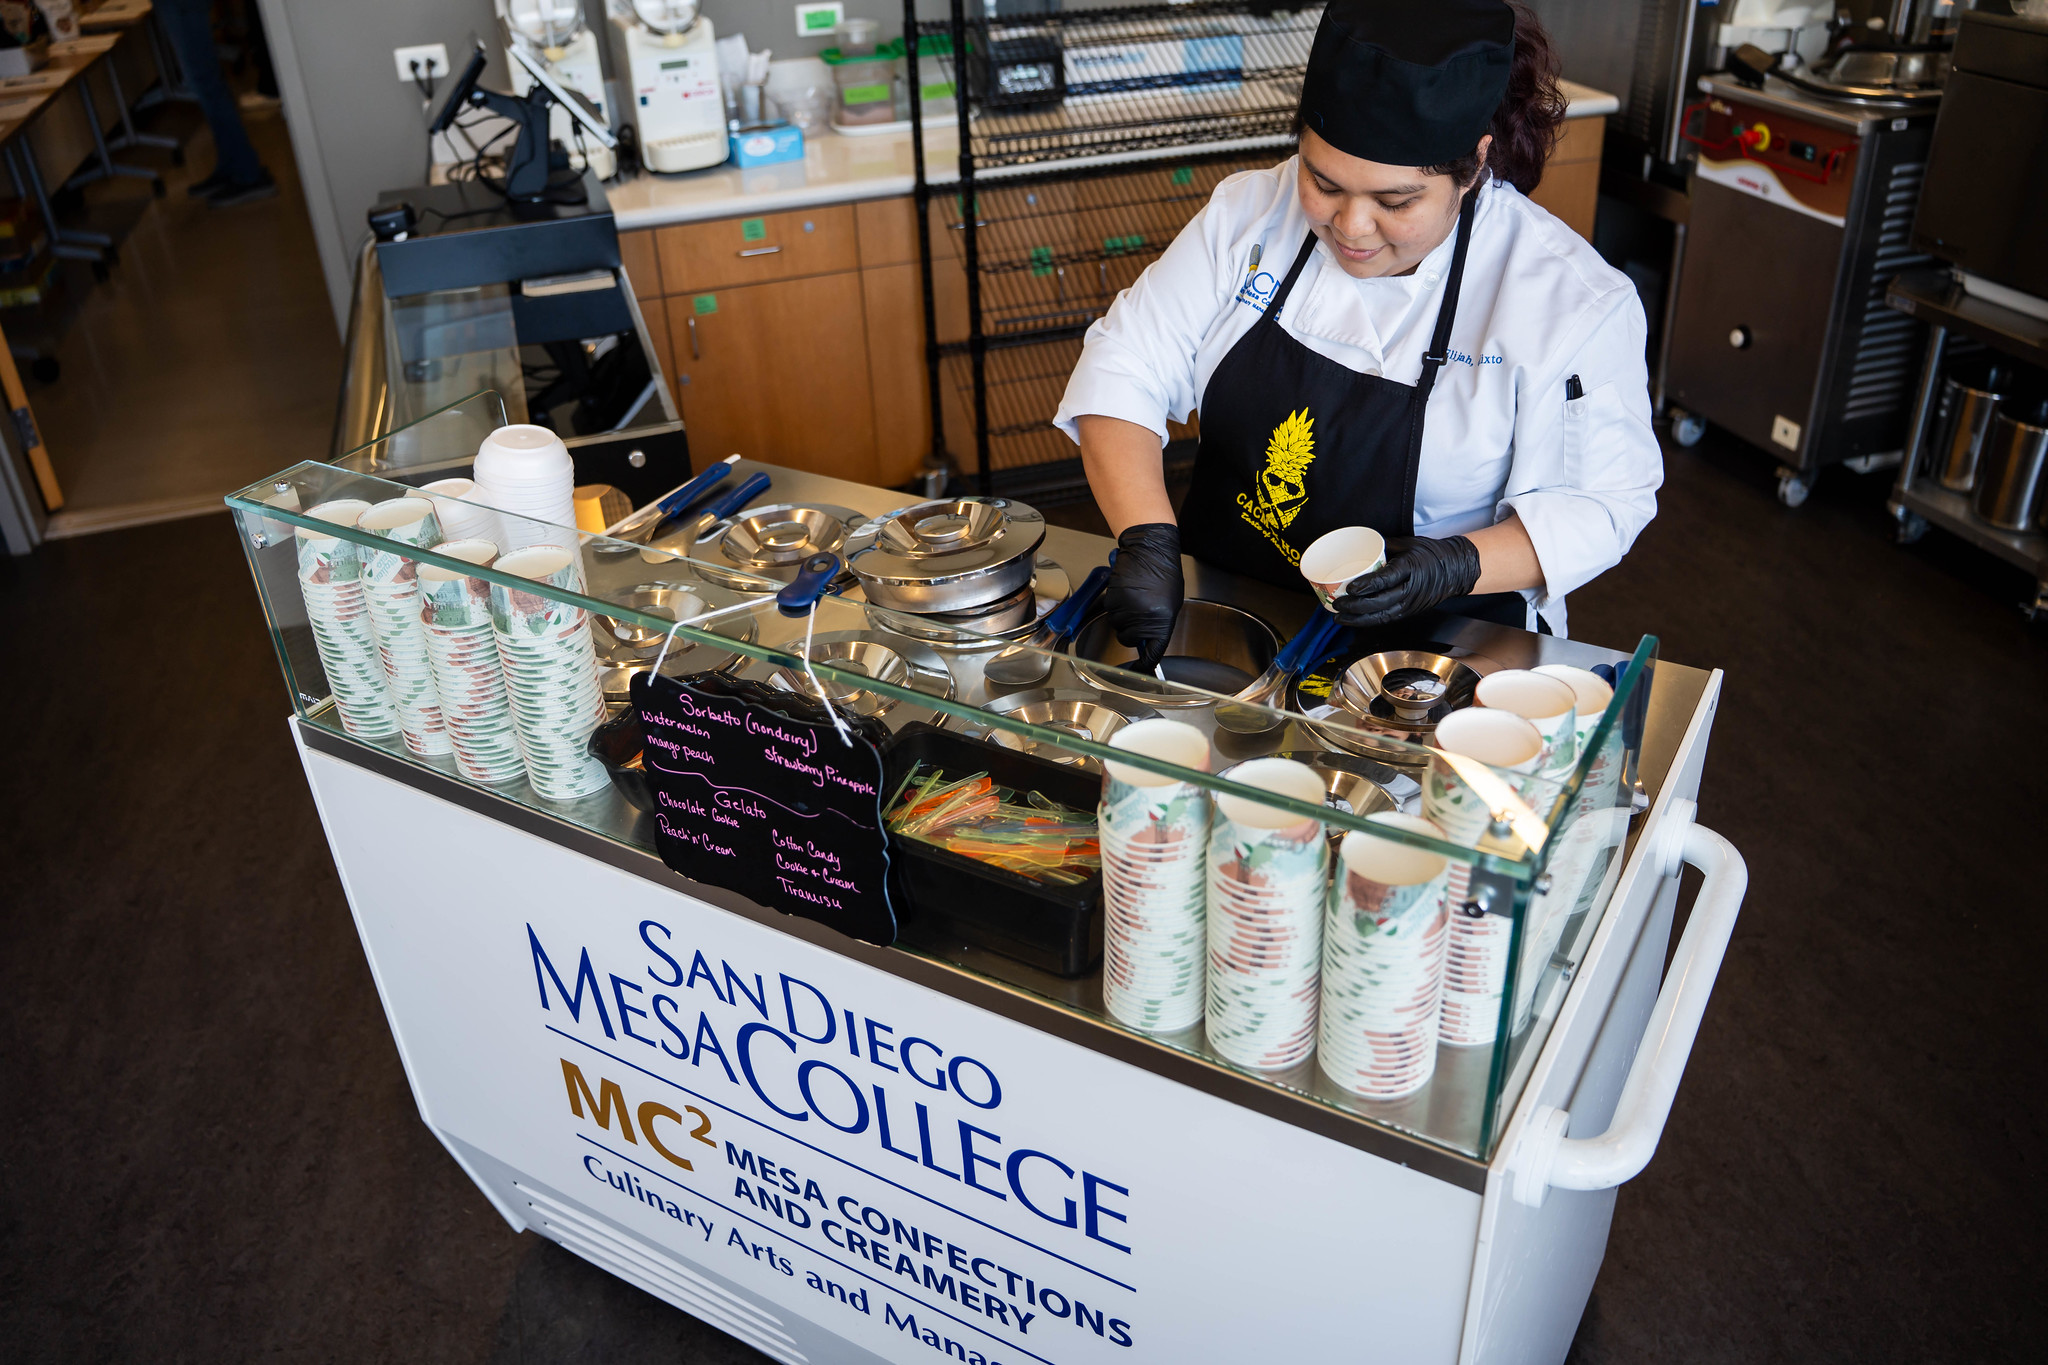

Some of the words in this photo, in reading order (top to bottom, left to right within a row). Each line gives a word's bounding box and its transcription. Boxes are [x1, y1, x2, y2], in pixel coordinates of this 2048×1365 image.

[1478, 353, 1503, 366] ixto
[679, 693, 741, 727] Sorbetto
[647, 734, 681, 760] mango
[682, 745, 716, 765] peach
[825, 764, 877, 796] Pineapple
[659, 791, 707, 817] Chocolate
[711, 807, 740, 829] Cookie
[714, 790, 767, 820] Gelato
[702, 833, 737, 858] Cream
[772, 828, 804, 853] Cotton
[807, 840, 841, 872] Candy
[776, 852, 809, 876] Cookie
[823, 867, 862, 894] Cream
[776, 875, 843, 910] Tiramisu
[638, 920, 770, 1018] SAN
[779, 972, 1002, 1109] DIEGO
[526, 922, 741, 1084] MESA
[736, 1023, 1132, 1255] COLLEGE
[583, 1154, 714, 1242] Culinary
[726, 1227, 795, 1278] Arts
[806, 1270, 870, 1317] and
[725, 1140, 828, 1209] MESA
[836, 1195, 1134, 1348] CONFECTIONS
[733, 1177, 812, 1230] AND
[820, 1219, 1036, 1335] CREAMERY
